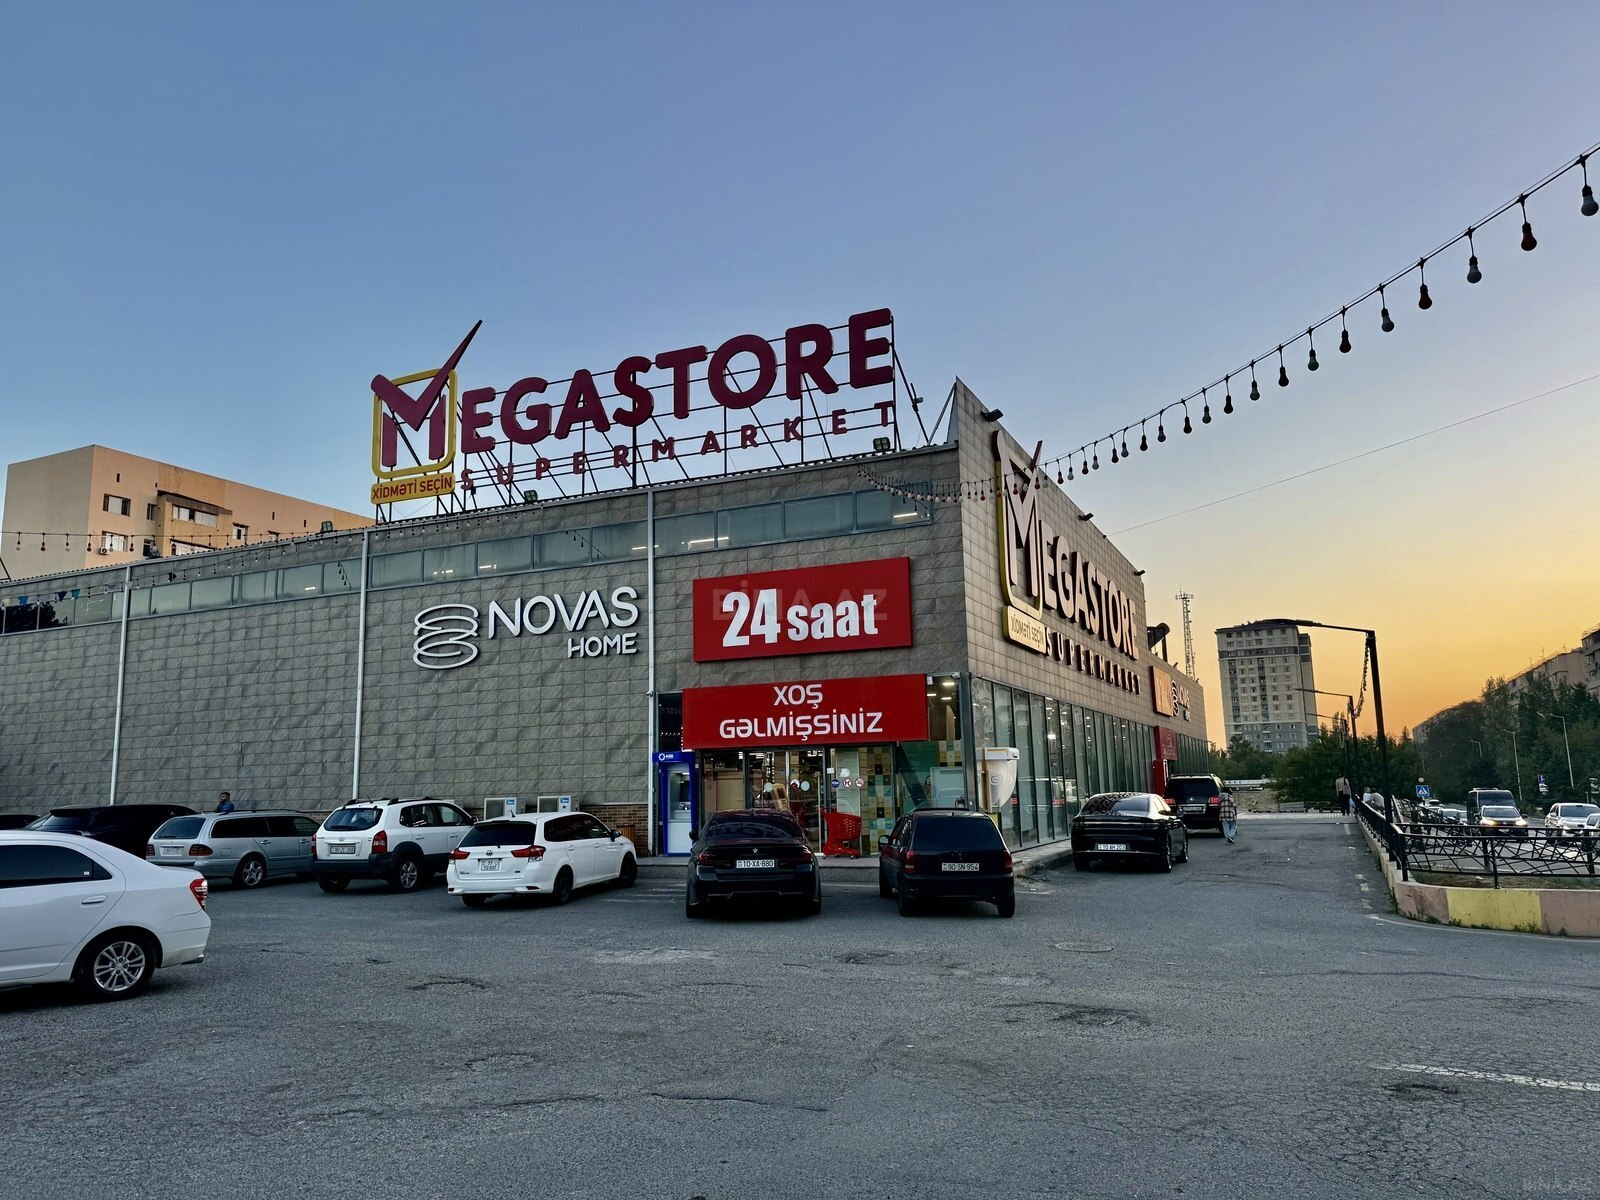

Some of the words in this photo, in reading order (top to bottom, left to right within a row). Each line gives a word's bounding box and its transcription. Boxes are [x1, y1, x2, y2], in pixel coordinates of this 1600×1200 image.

[371, 308, 894, 468] MEGASTORE
[460, 401, 896, 491] SUPERMARKET
[373, 479, 417, 500] XİDMƏTİ
[419, 475, 453, 494] SEÇİN
[488, 586, 639, 640] NOVAS
[722, 588, 781, 648] 24
[787, 593, 879, 642] saat
[567, 632, 638, 658] HOME
[1045, 630, 1141, 695] SUPERMARKET
[719, 706, 884, 740] GƏLMİŞSİNİZ
[773, 683, 824, 709] XOŞ
